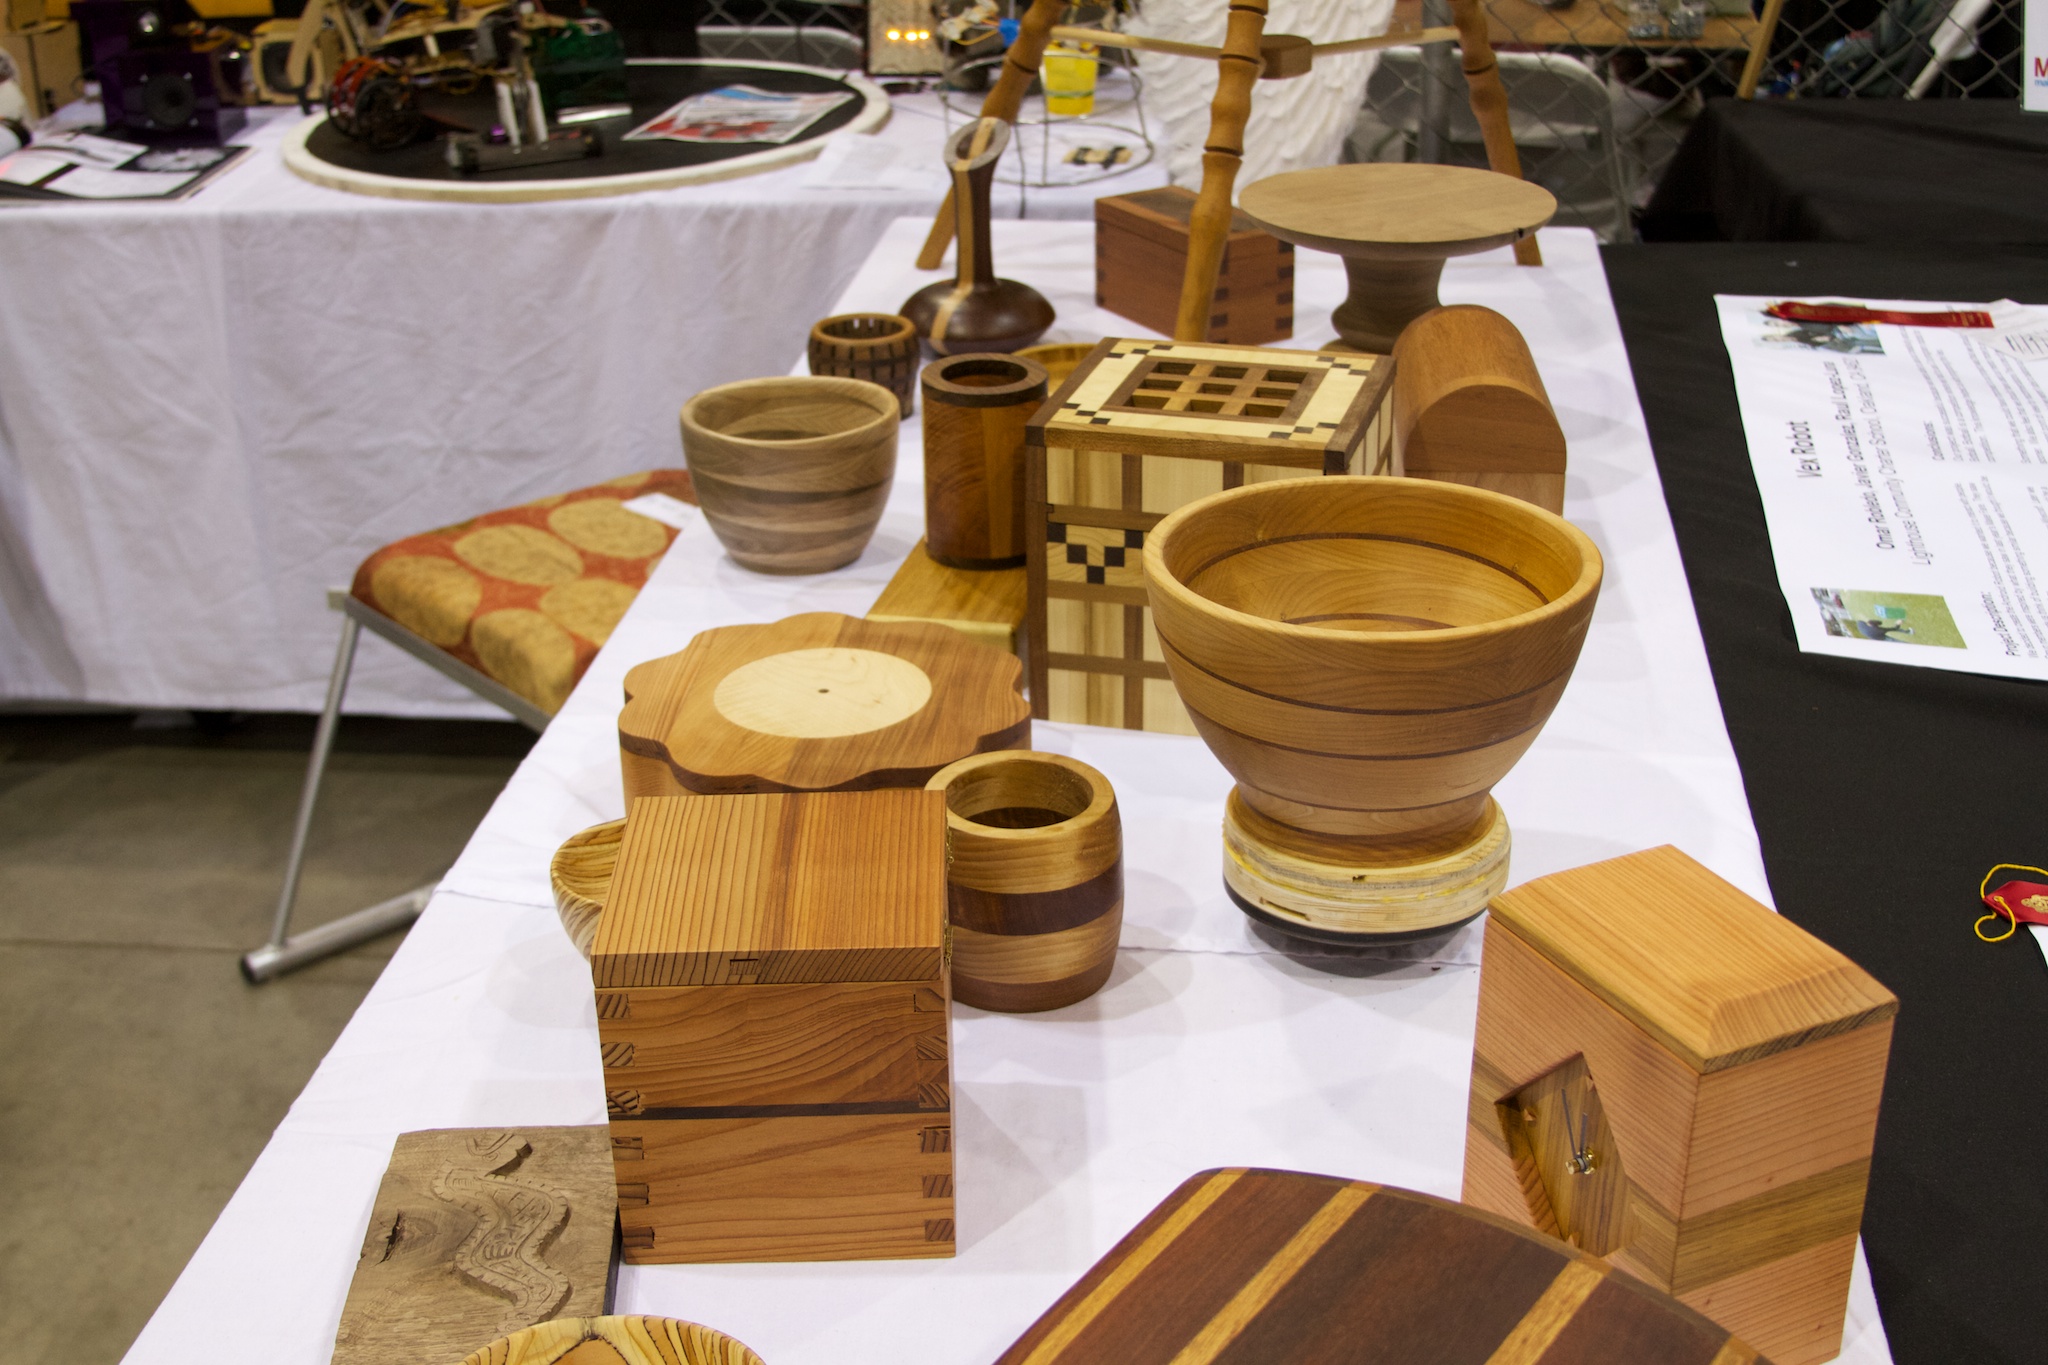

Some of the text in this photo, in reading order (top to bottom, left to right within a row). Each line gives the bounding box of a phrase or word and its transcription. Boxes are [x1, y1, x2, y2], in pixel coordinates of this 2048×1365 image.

[1832, 402, 1853, 420] Raul
[1787, 420, 1824, 479] Vex Robot
[1840, 424, 1864, 461] Gonzalez,
[1852, 464, 1873, 488] Javier
[1876, 448, 1897, 475] Charter
[1884, 478, 1913, 518] Community
[1875, 526, 1895, 550] Omar
[1903, 521, 1934, 565] Lighthouse
[1981, 592, 2021, 657] Project Description:
